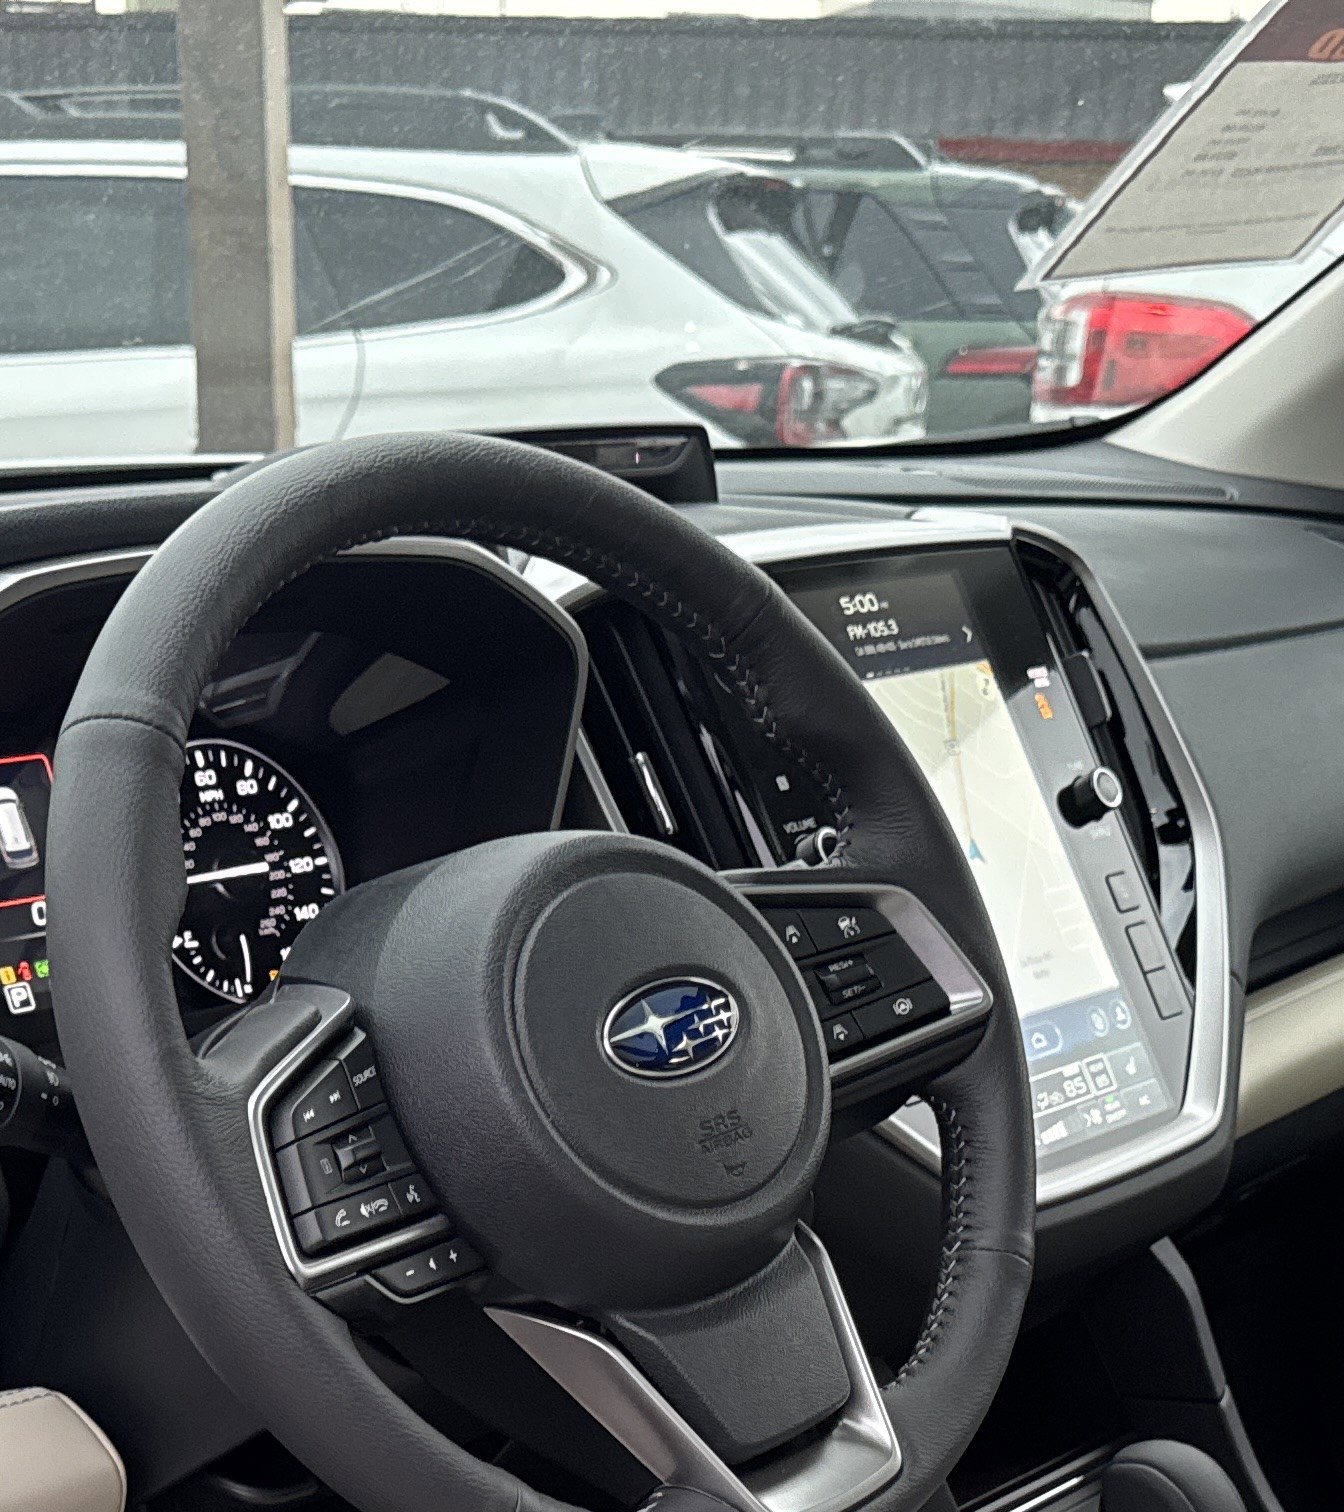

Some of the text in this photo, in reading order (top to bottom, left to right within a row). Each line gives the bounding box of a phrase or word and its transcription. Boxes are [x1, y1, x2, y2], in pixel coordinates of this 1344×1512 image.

[194, 768, 217, 787] 60
[236, 778, 258, 796] 80
[267, 811, 293, 830] 100
[782, 816, 817, 834] VOLUME
[288, 856, 314, 874] 120
[293, 902, 319, 922] 140
[352, 1065, 377, 1088] SOURCE
[1062, 1075, 1088, 1098] 85
[698, 1109, 742, 1138] SRS
